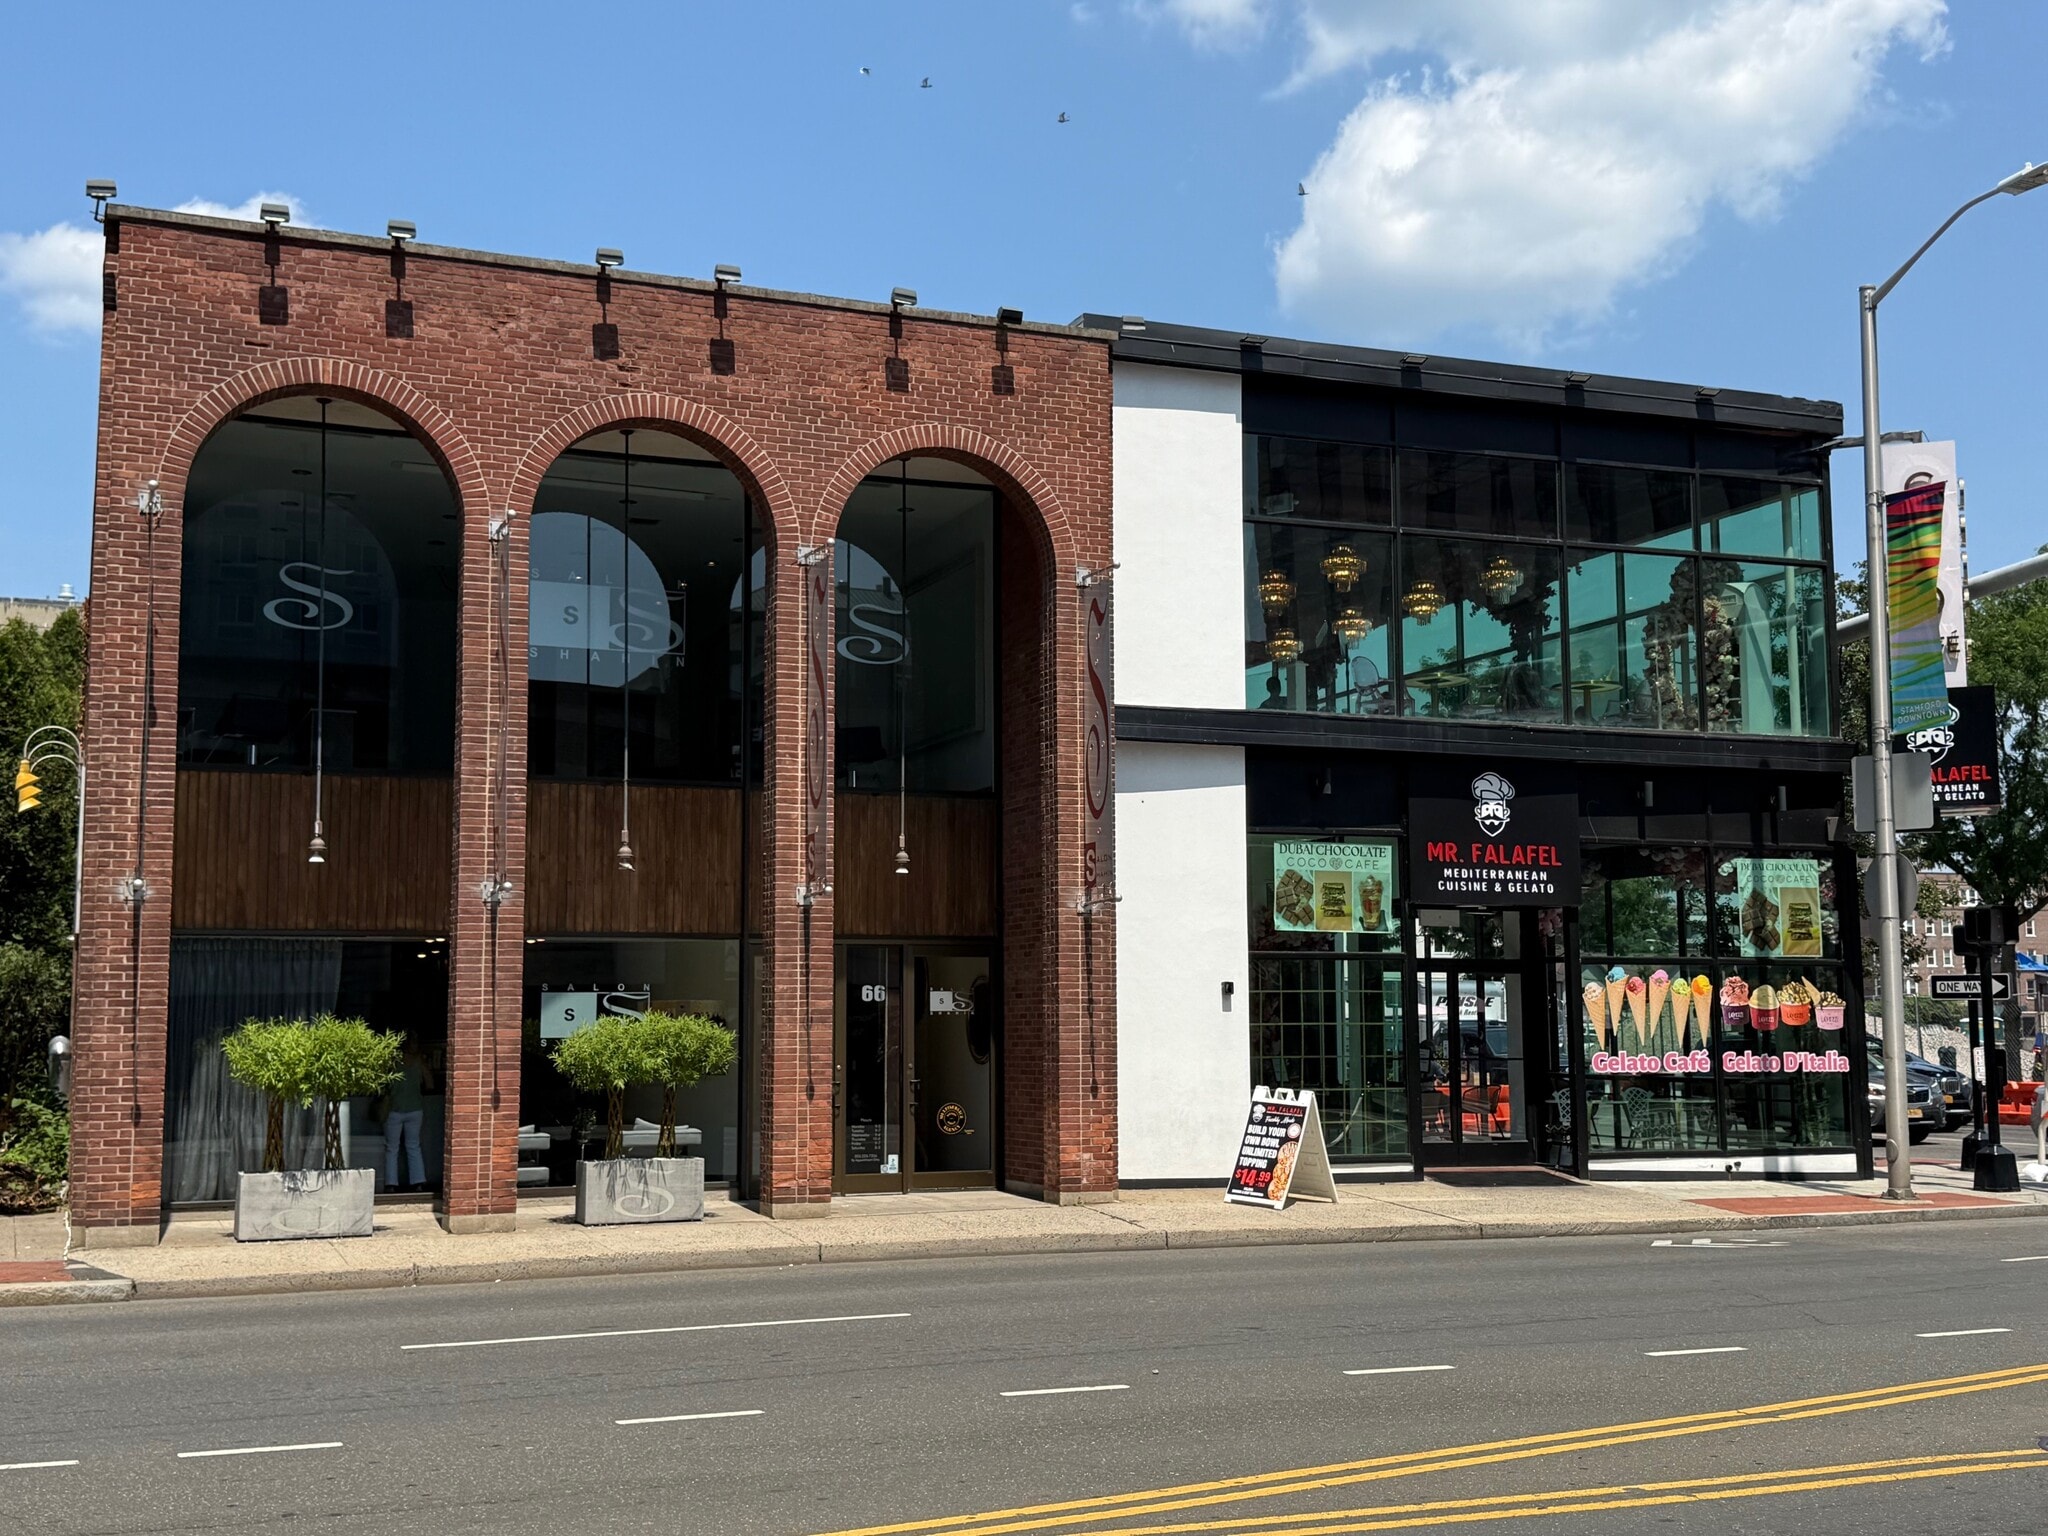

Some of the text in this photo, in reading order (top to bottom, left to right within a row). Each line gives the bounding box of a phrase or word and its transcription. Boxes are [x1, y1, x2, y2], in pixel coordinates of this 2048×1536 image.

[563, 606, 579, 624] S
[1900, 700, 1941, 715] STAMFORD
[1897, 709, 1946, 724] DOWNTOWN
[1930, 765, 1992, 783] ALAFEL
[1945, 792, 1985, 801] GELATO
[1279, 843, 1387, 858] DUBAI CHOCOLATE
[1427, 841, 1562, 866] MR. FALAFEL
[1286, 857, 1380, 870] COCO CAFE
[1766, 863, 1814, 873] CHOCOLATE
[1443, 868, 1548, 881] MEDITERRANEAN
[1746, 875, 1811, 884] COCO CAFE
[1438, 880, 1554, 893] CUISINE & GELATO
[542, 983, 650, 992] SALON
[1939, 982, 1960, 991] ONE
[861, 985, 886, 1002] 66
[564, 1008, 575, 1021] S
[1592, 1048, 1711, 1073] Gelato Café
[1722, 1050, 1850, 1072] Gelato D'Italia
[1247, 1124, 1287, 1138] BUILD YOUR
[1244, 1135, 1280, 1148] OWN BOWL
[1241, 1146, 1277, 1159] UNLIMITED
[1239, 1157, 1268, 1169] TOPPING
[1235, 1168, 1271, 1187] $14.99
